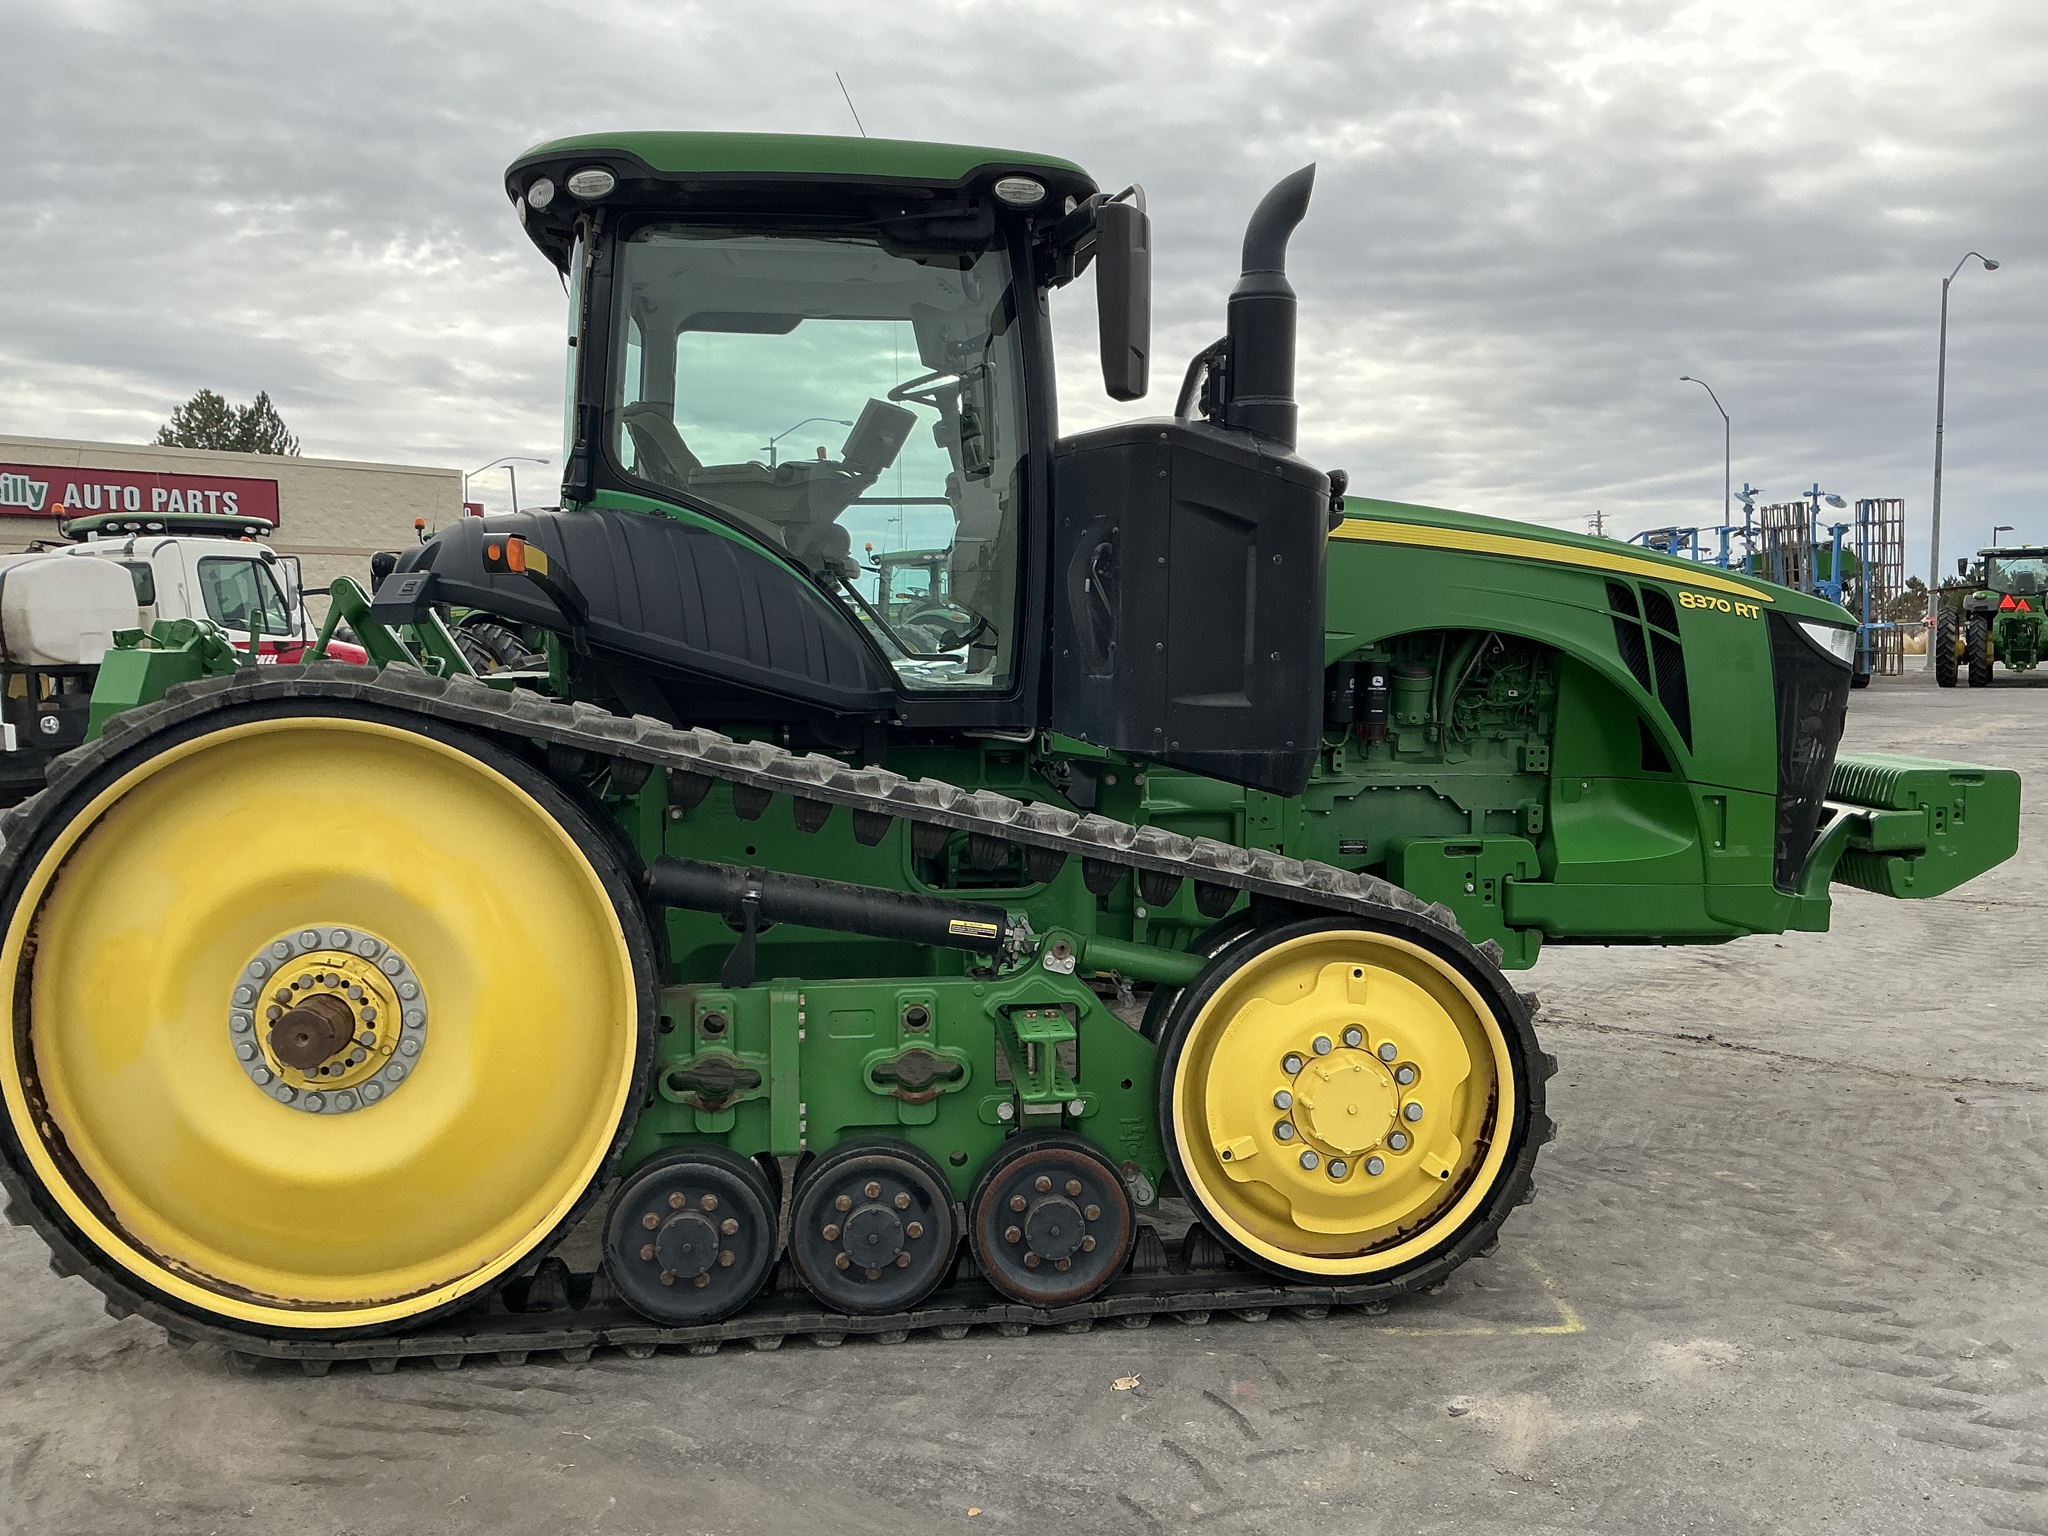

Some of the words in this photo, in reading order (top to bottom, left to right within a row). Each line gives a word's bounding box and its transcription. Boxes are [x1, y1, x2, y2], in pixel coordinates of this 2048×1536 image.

[0, 473, 48, 511] illy
[63, 483, 140, 511] AUTO
[151, 488, 239, 515] PARTS
[1678, 591, 1731, 613] 8370
[1734, 602, 1760, 620] RT
